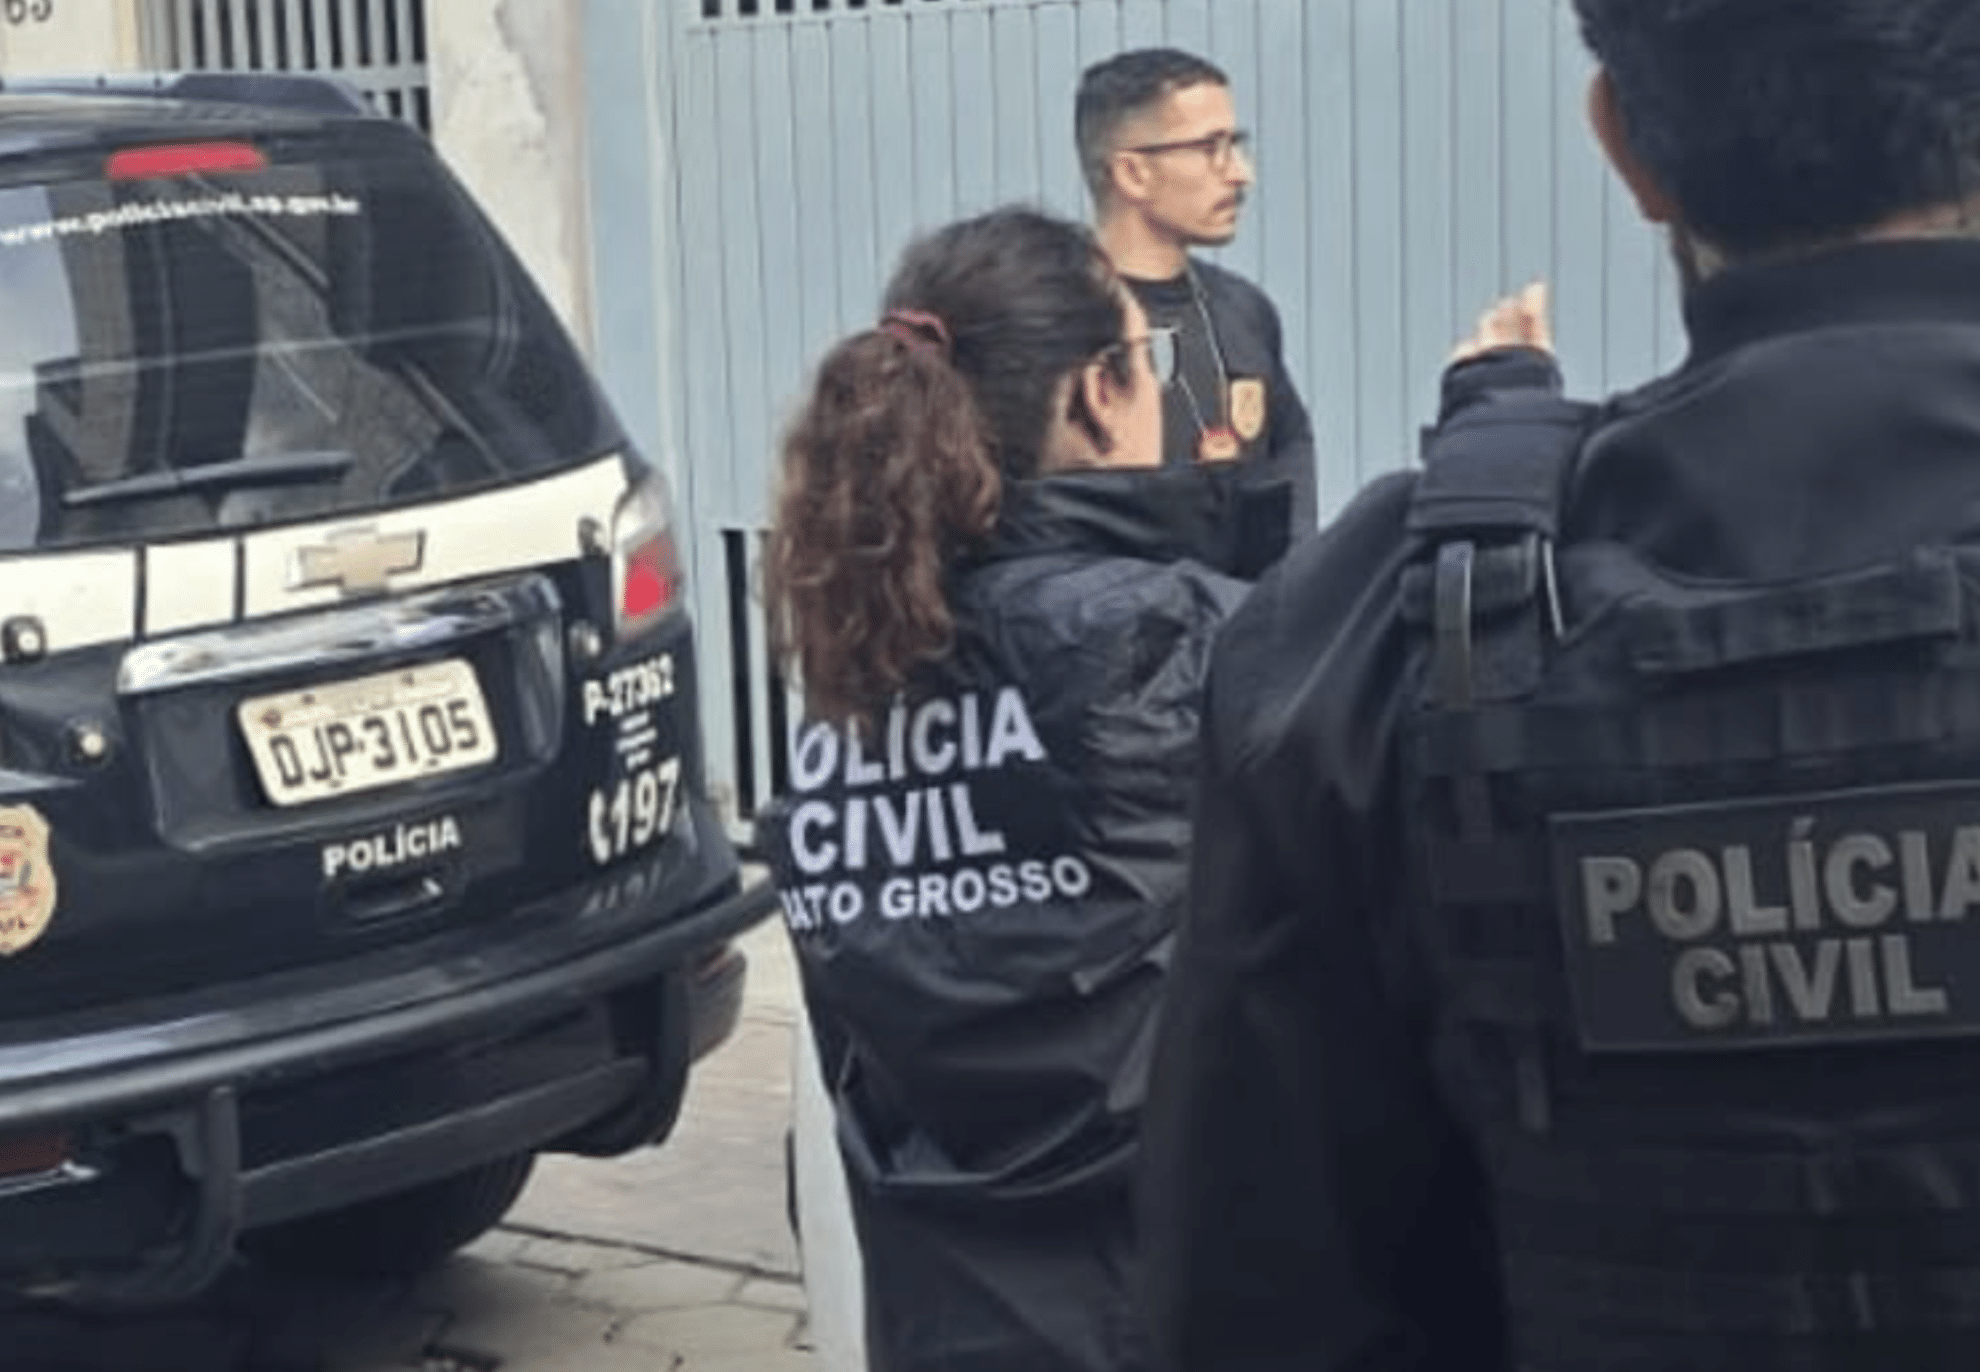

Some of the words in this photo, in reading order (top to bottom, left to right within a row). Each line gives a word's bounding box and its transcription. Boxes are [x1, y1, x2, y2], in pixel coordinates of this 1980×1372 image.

[786, 687, 1046, 791] OLÍCIA
[323, 815, 461, 877] POLÍCIA
[611, 757, 681, 856] 197
[790, 782, 1005, 873] CIVIL
[880, 855, 1090, 919] GROSSO
[1581, 816, 1980, 945] POLÍCIA
[1674, 934, 1948, 1028] CIVIL
